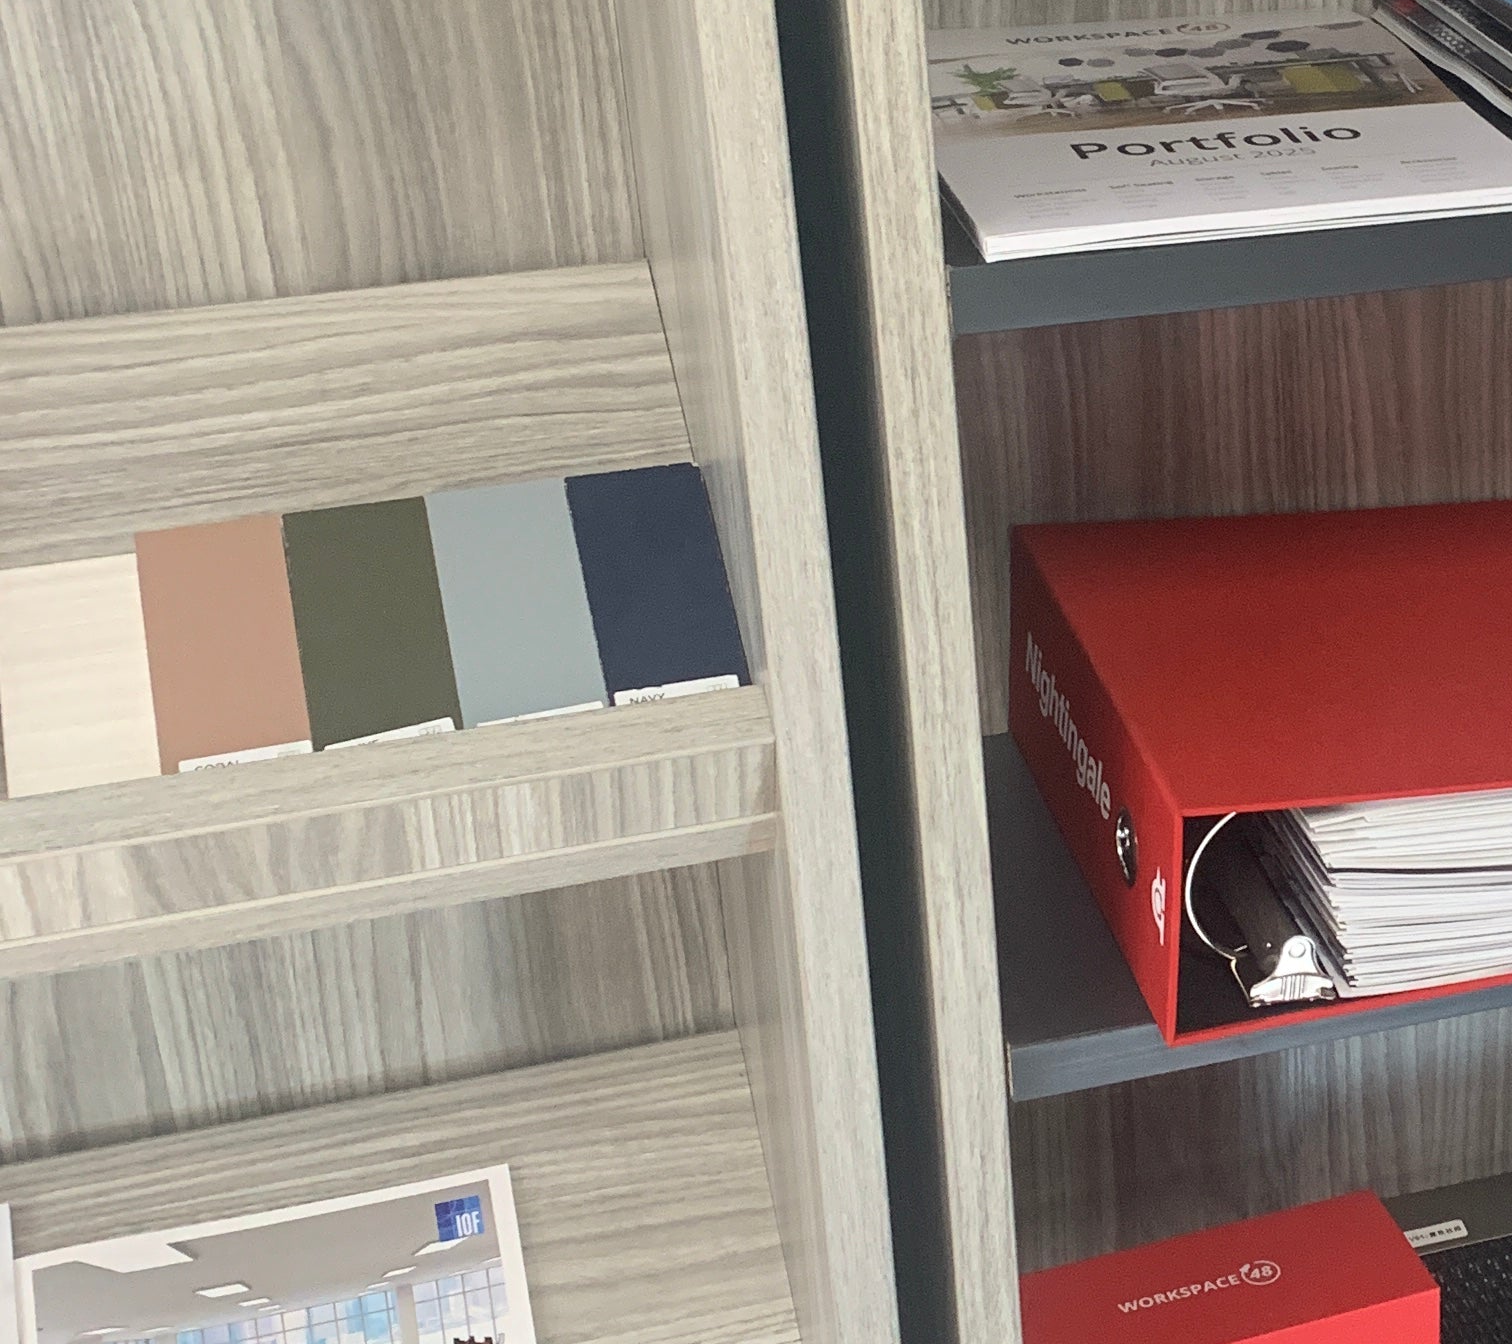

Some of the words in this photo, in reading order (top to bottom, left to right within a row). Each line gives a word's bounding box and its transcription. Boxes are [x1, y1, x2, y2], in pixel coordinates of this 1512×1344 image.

[1006, 28, 1172, 45] WORKSPACE
[1070, 122, 1361, 160] Portfolio
[1150, 153, 1245, 168] August
[1253, 148, 1316, 159] 2025
[1026, 631, 1111, 820] Nightingale
[455, 1210, 482, 1238] IOF
[1118, 1273, 1240, 1314] WORKSPACE
[1249, 1265, 1273, 1280] 48
